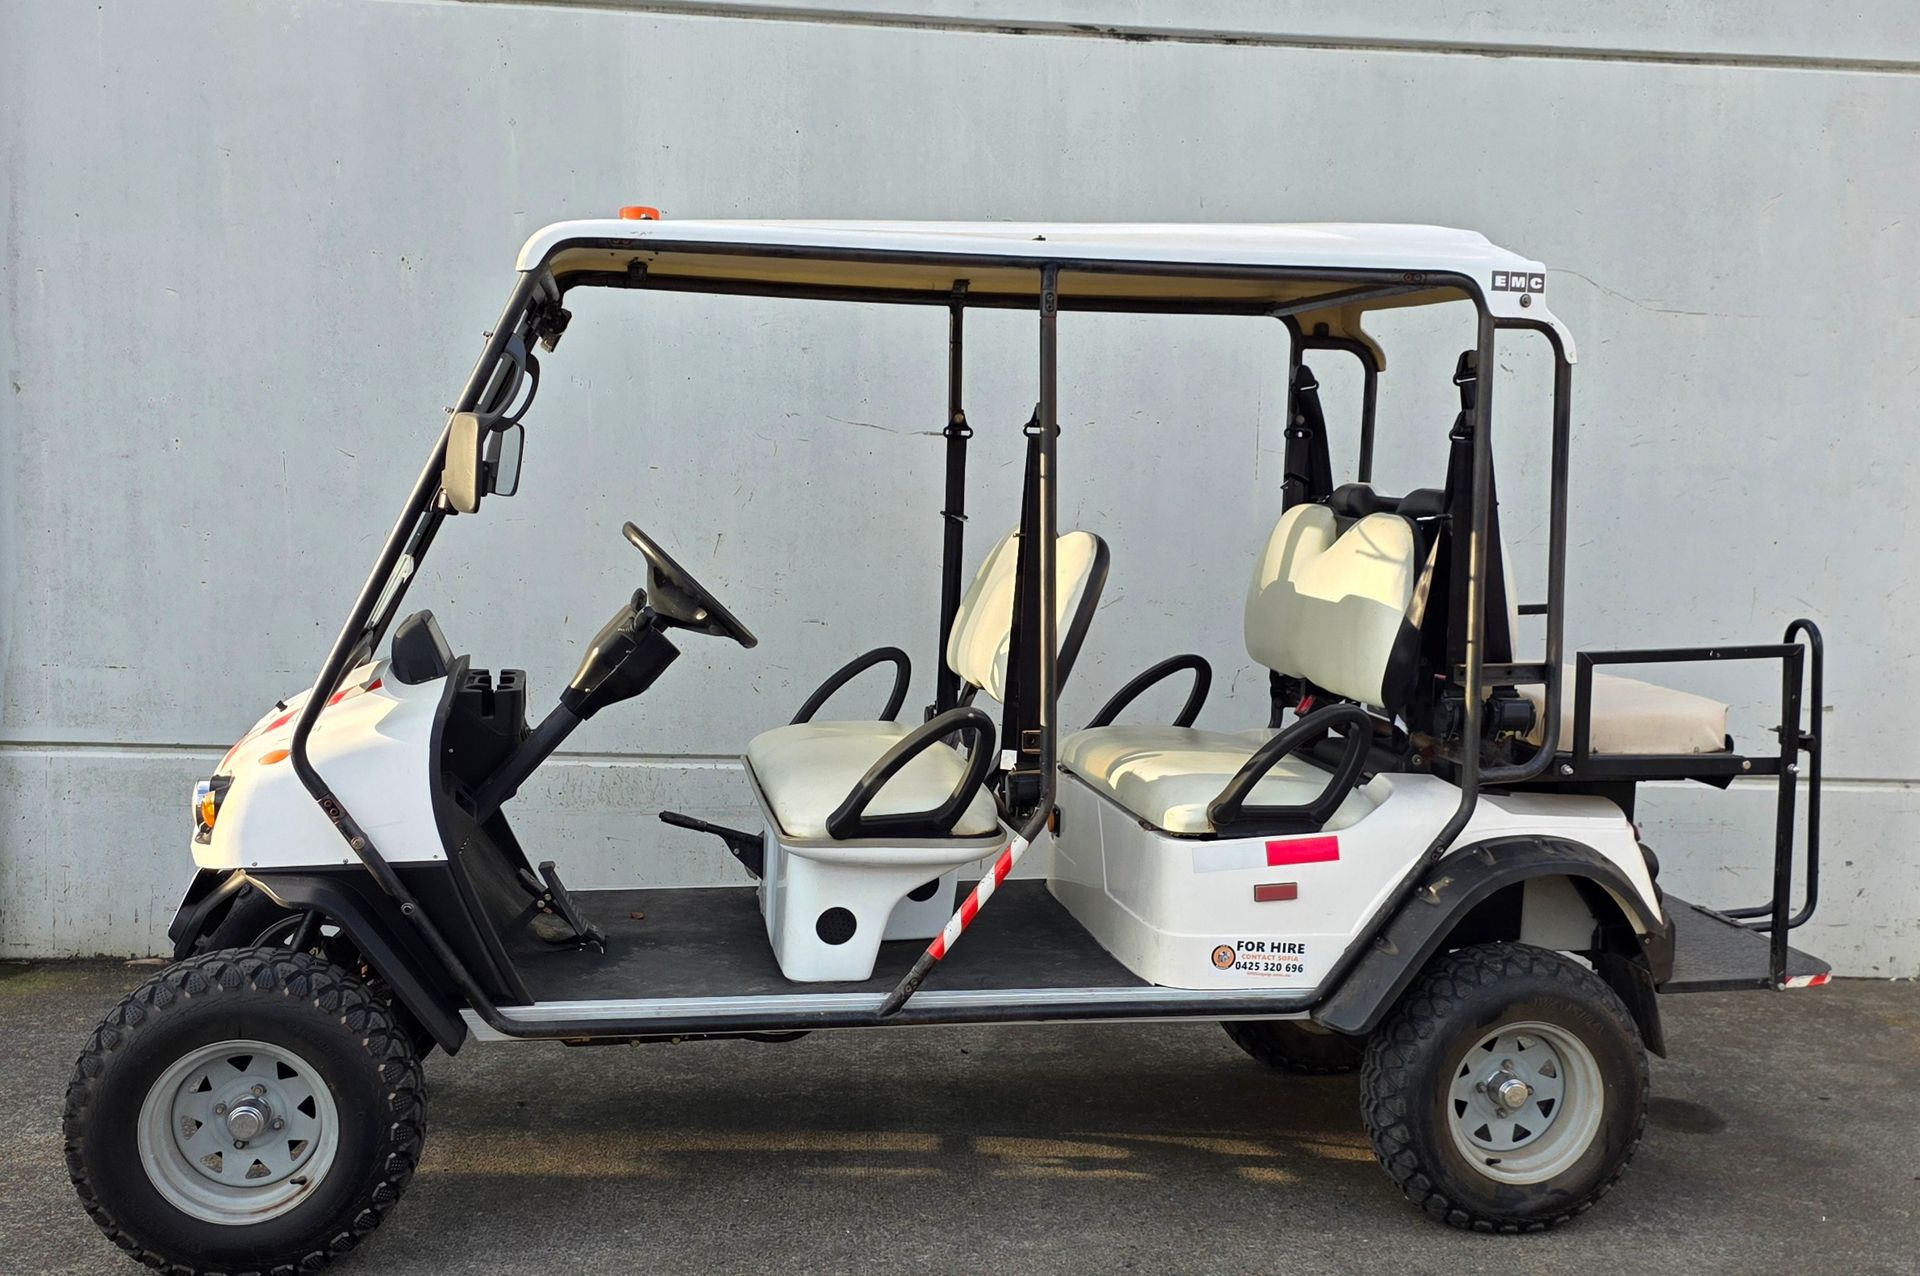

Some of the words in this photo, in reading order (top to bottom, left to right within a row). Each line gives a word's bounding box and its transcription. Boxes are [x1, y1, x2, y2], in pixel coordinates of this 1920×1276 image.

[1495, 275, 1543, 289] EMC
[1237, 941, 1265, 952] FOR
[1270, 942, 1305, 954] HIRE
[1235, 961, 1260, 970] 0425
[1263, 963, 1282, 972] 320
[1285, 964, 1304, 973] 696
